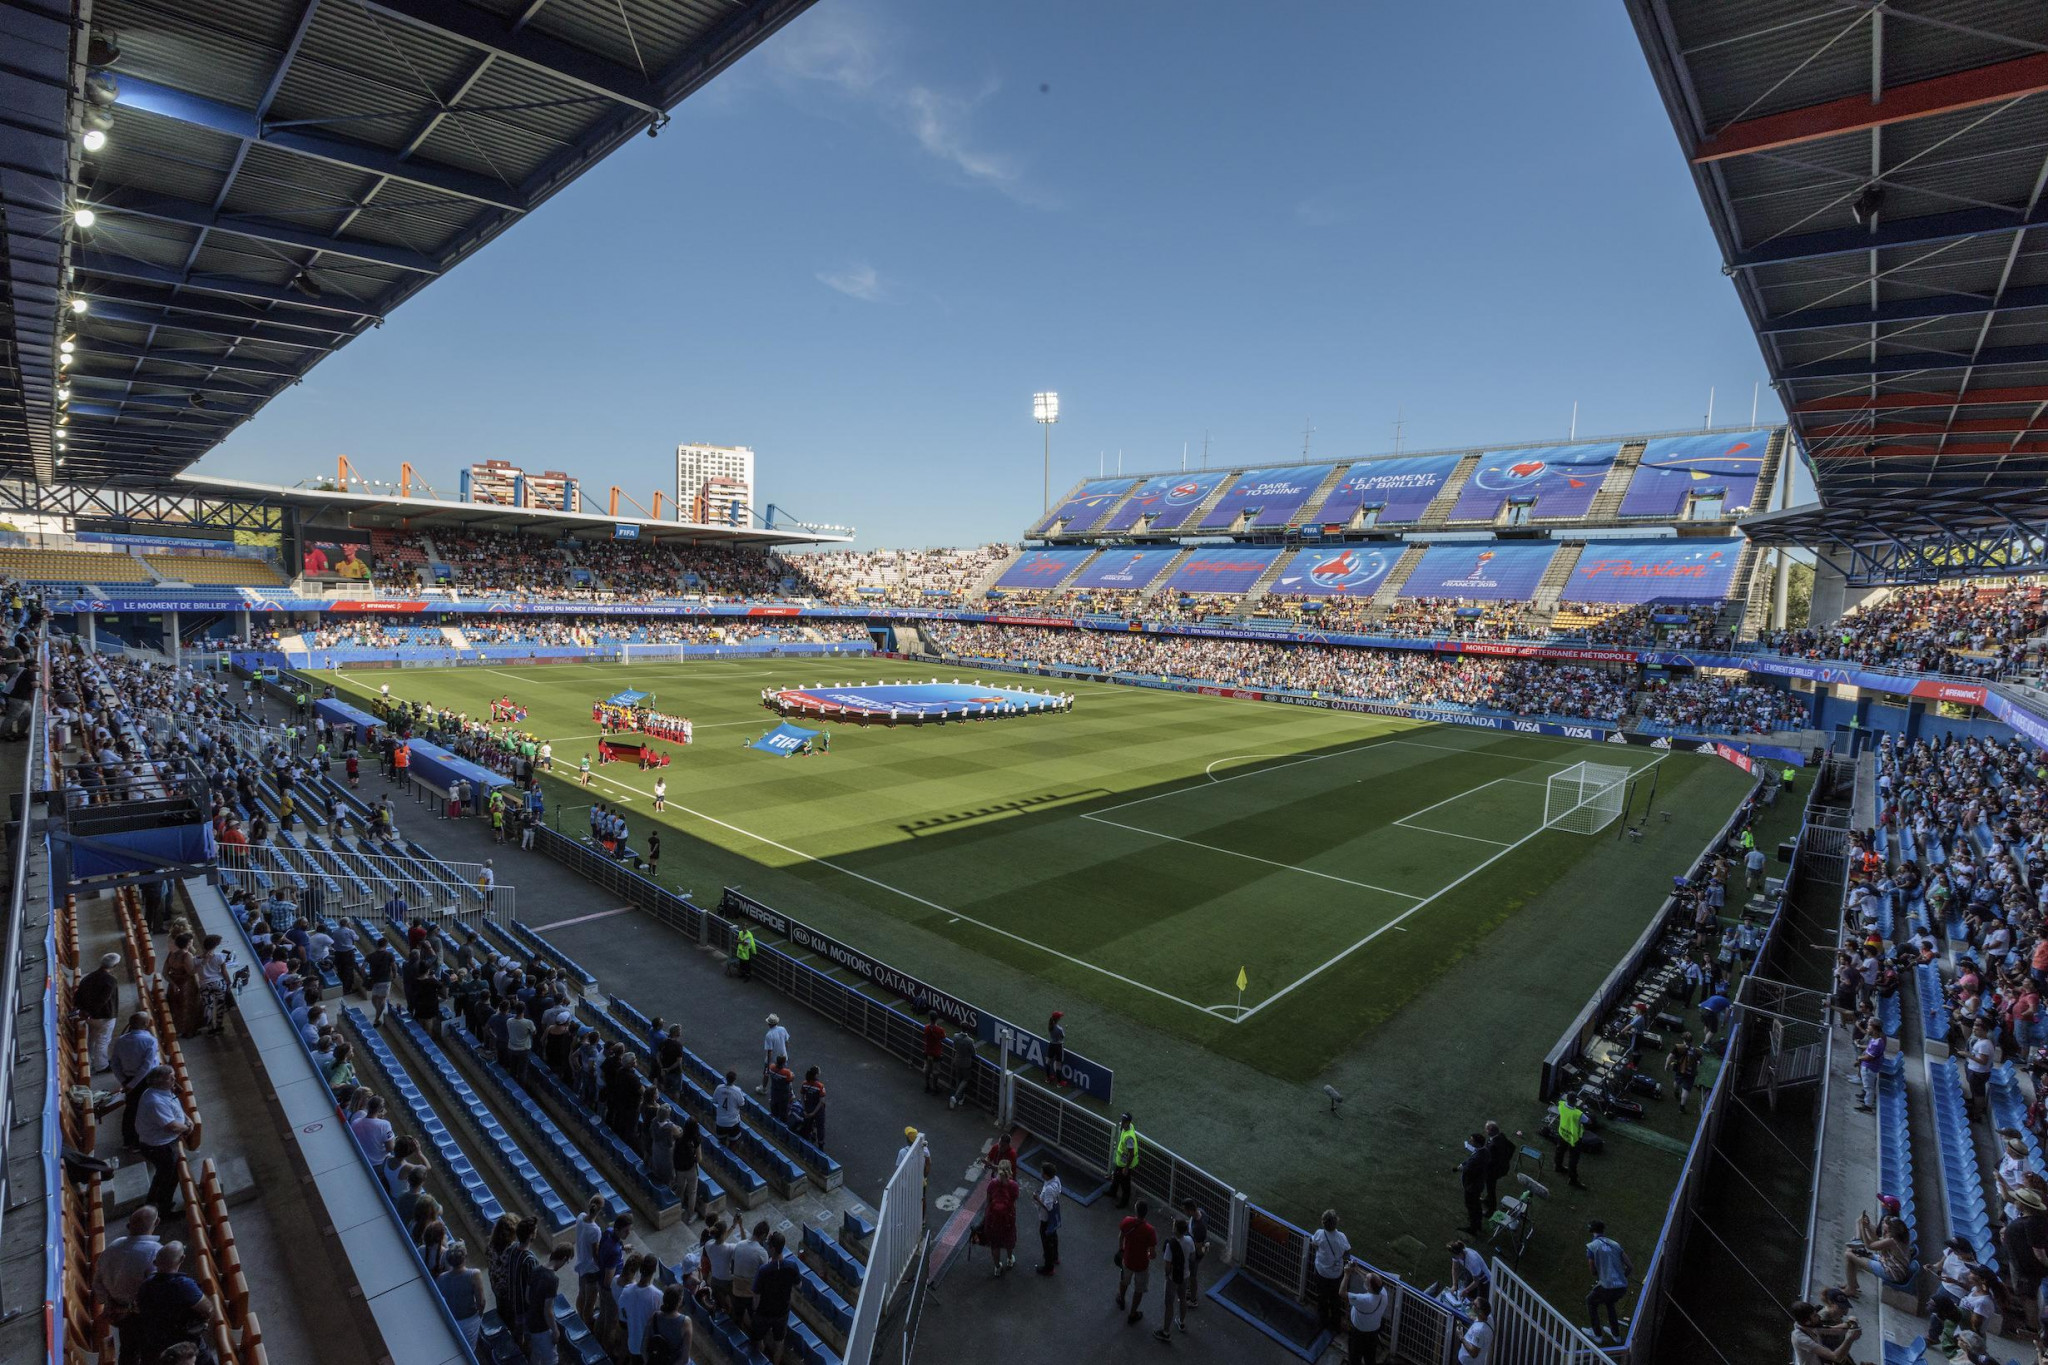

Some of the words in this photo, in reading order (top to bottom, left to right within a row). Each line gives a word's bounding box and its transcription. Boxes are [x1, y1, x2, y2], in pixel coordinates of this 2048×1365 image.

[1258, 482, 1291, 490] DARE
[1349, 477, 1368, 485] LE
[1368, 473, 1437, 484] MOMENT
[1354, 483, 1374, 491] DE
[1375, 479, 1436, 489] BRILLER
[1262, 487, 1301, 495] SHINE
[1580, 559, 1707, 580] Passion
[1465, 644, 1517, 654] MONTPELLIER
[1580, 649, 1632, 661] MÉTROPOLE
[1281, 696, 1294, 704] KIA
[1294, 697, 1328, 709] MOTORS
[1331, 701, 1364, 713] QATAR
[1366, 704, 1412, 718] AIRWAYS
[1512, 720, 1541, 733] VISA
[1561, 726, 1593, 740] VISA
[768, 734, 801, 750] FIFA
[811, 936, 828, 954] KIA
[830, 945, 872, 977] MOTORS
[874, 966, 915, 997] QATAR
[919, 988, 978, 1028] AIRWAYS
[722, 1097, 729, 1112] 4
